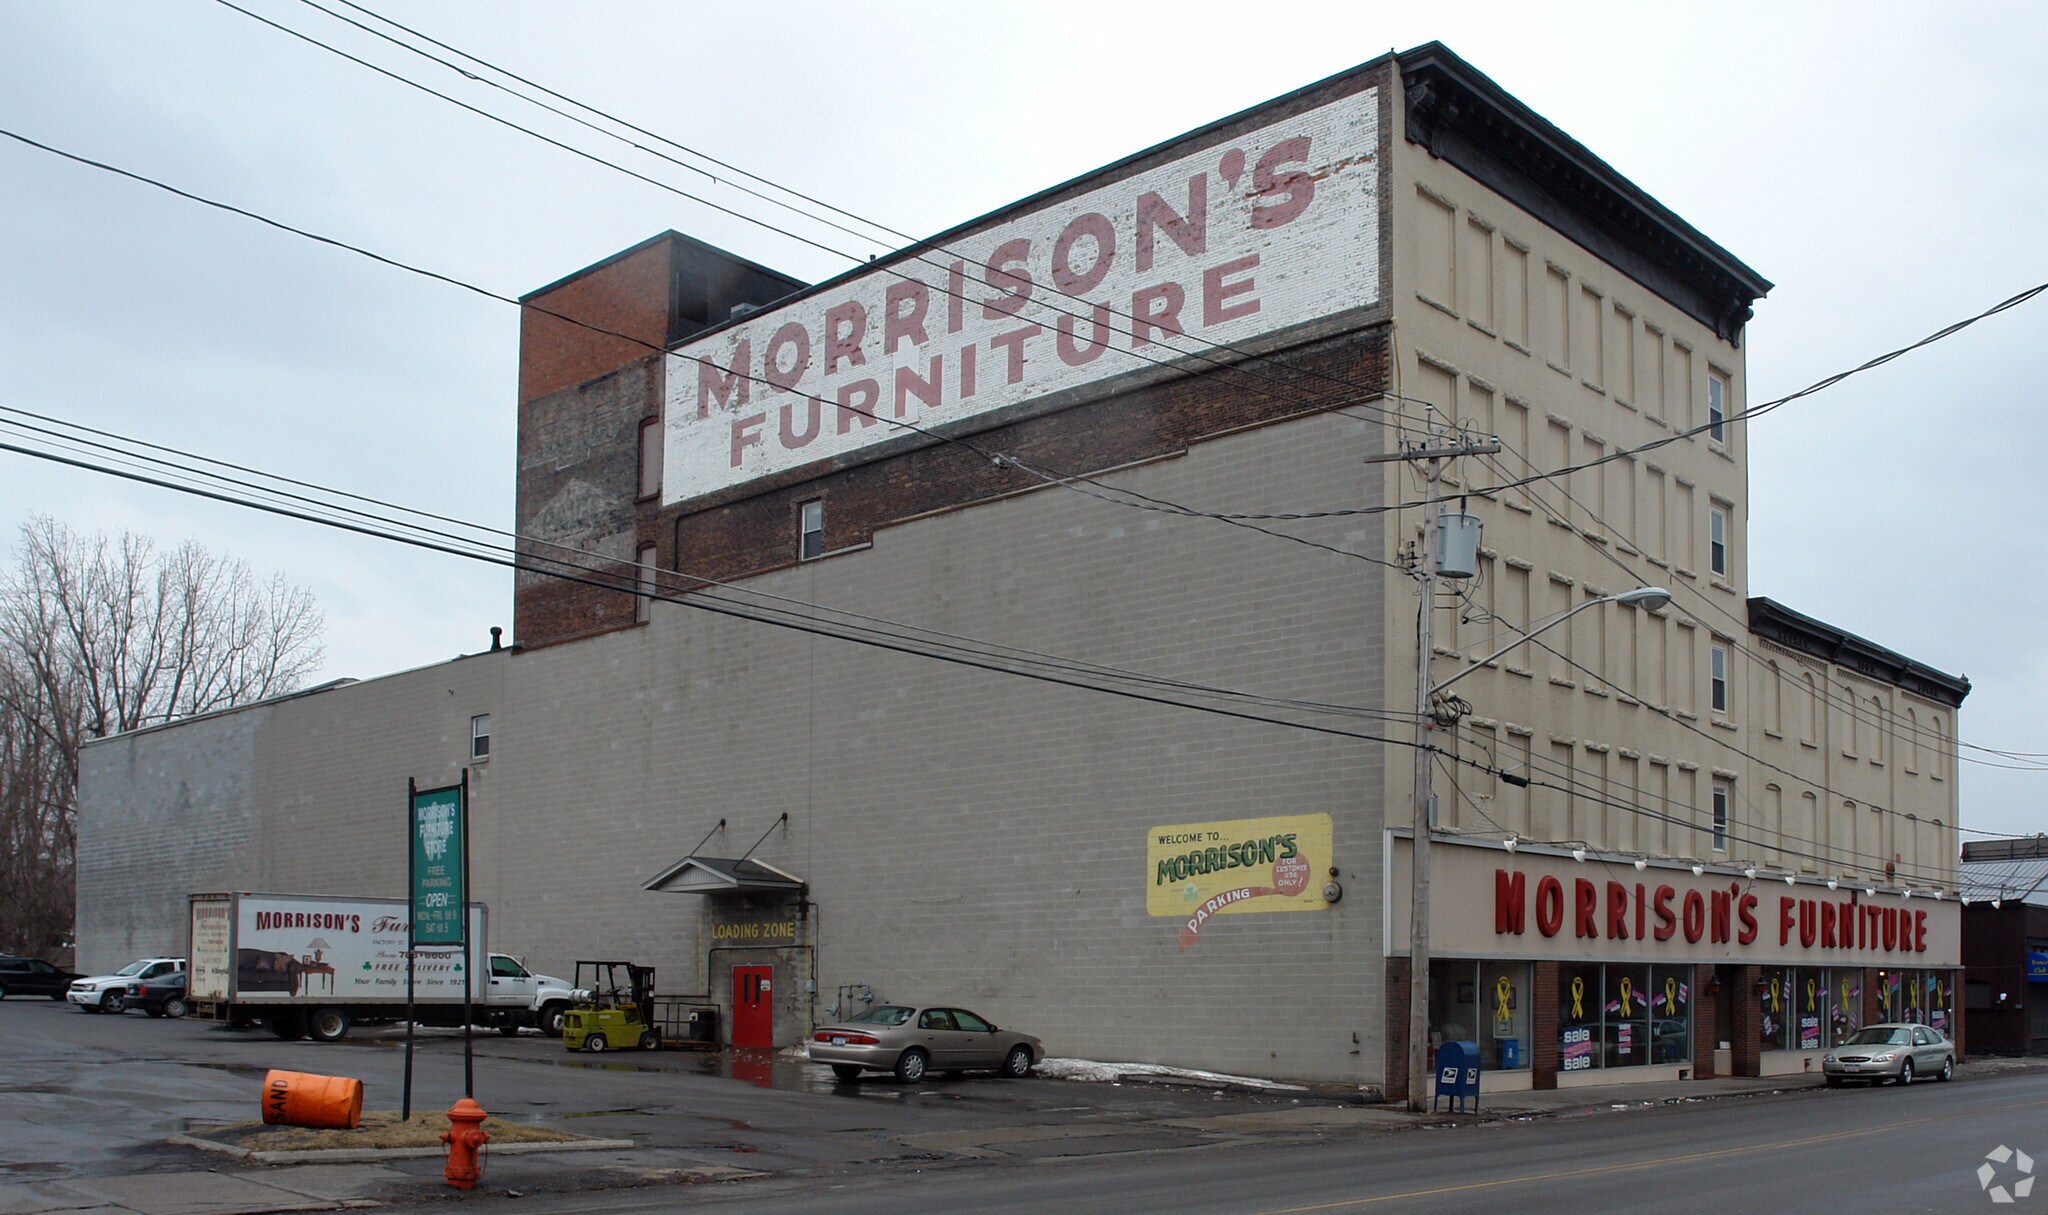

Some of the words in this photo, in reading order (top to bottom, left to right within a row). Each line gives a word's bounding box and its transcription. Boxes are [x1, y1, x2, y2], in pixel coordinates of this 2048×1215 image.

[697, 135, 1317, 420] MORRISON'S
[730, 253, 1261, 467] FURNITURE
[426, 838, 447, 854] STORE
[1158, 833, 1203, 845] WELCOME
[1157, 833, 1298, 886] MORRISON'S
[1282, 857, 1297, 865] FOR
[427, 865, 446, 876] FREE
[1276, 864, 1307, 873] CUSTOMER
[421, 876, 453, 888] PARKING
[425, 892, 449, 908] OPEN
[1495, 869, 1759, 945] MORRISON'S
[1187, 888, 1251, 934] PARKING
[256, 911, 361, 933] MORRISON'S
[1780, 896, 1928, 952] FURNITURE
[712, 925, 758, 939] LOADING
[764, 923, 795, 937] ZONE
[375, 963, 401, 971] FREE
[375, 978, 398, 987] Family
[1801, 1016, 1819, 1028] sale
[1564, 1028, 1590, 1043] sale
[1801, 1038, 1818, 1049] sale
[1564, 1056, 1591, 1071] sale
[269, 1079, 288, 1121] SAND
